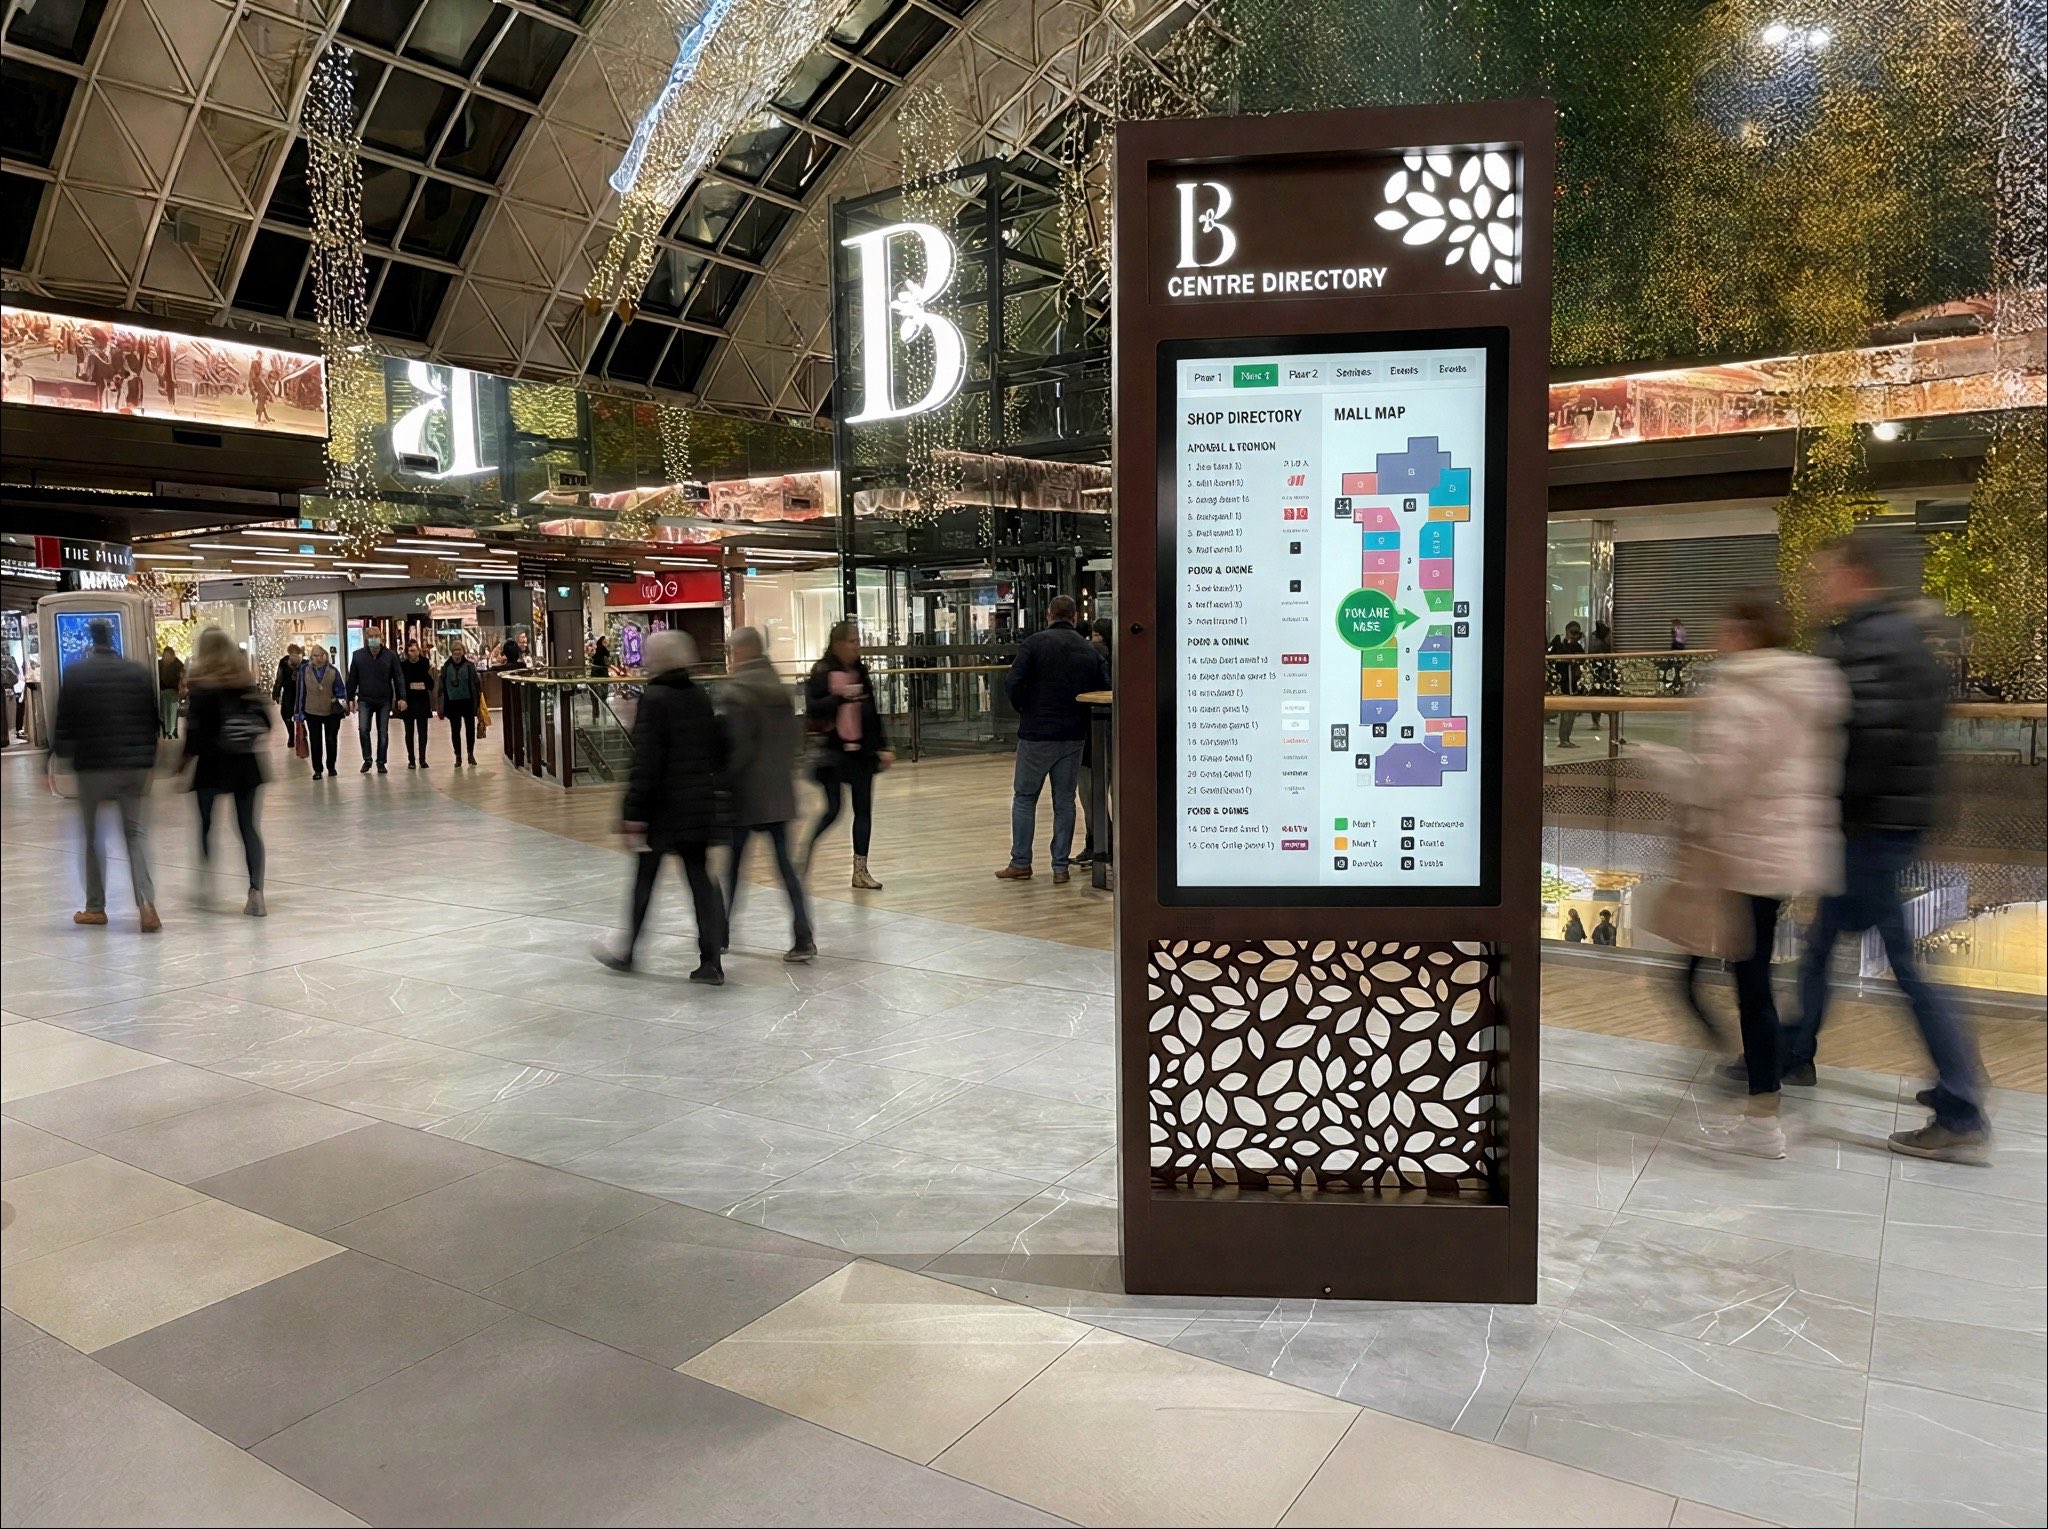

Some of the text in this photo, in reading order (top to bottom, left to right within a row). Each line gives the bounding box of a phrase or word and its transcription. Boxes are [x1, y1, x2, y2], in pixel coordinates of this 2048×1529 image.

[1175, 182, 1237, 269] B
[1168, 267, 1388, 298] CENTRE DIRECTORY
[840, 222, 967, 425] B
[1187, 409, 1302, 426] SHOP DIRECTORY
[1334, 406, 1406, 421] MALL MAP
